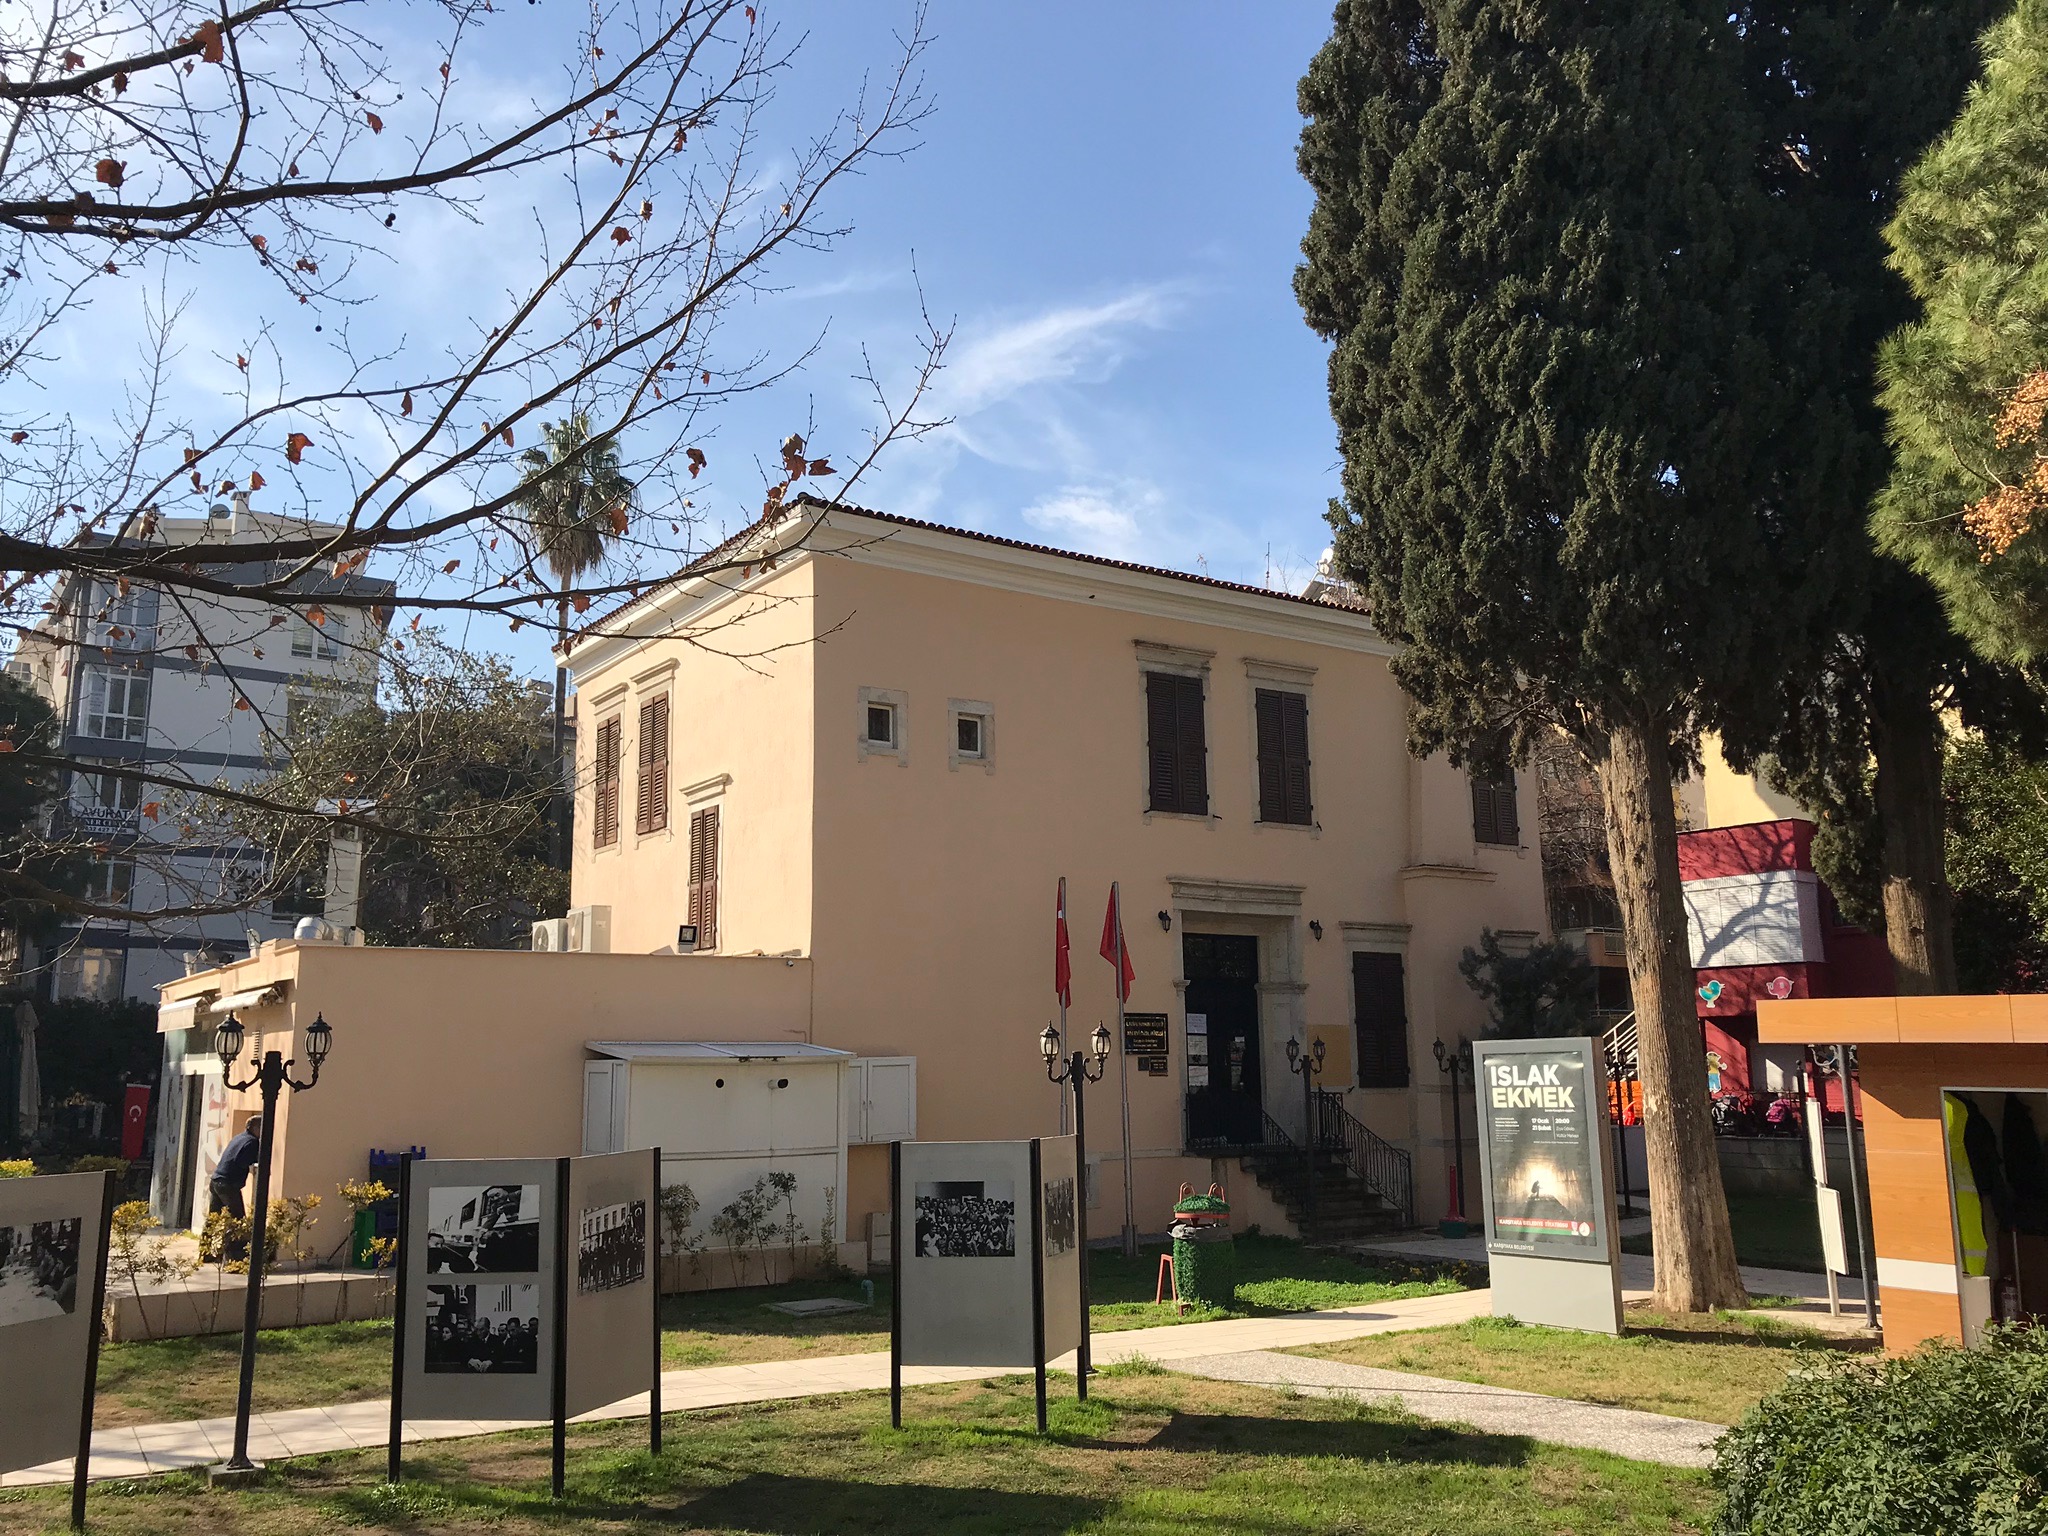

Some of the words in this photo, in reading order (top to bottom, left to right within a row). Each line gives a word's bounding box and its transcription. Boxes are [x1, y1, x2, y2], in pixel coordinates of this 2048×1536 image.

[81, 807, 130, 820] AVUKAT
[1490, 1064, 1560, 1086] ISLAK
[1492, 1086, 1575, 1108] EKMEK
[1493, 1242, 1514, 1250] KARŞIYAKA
